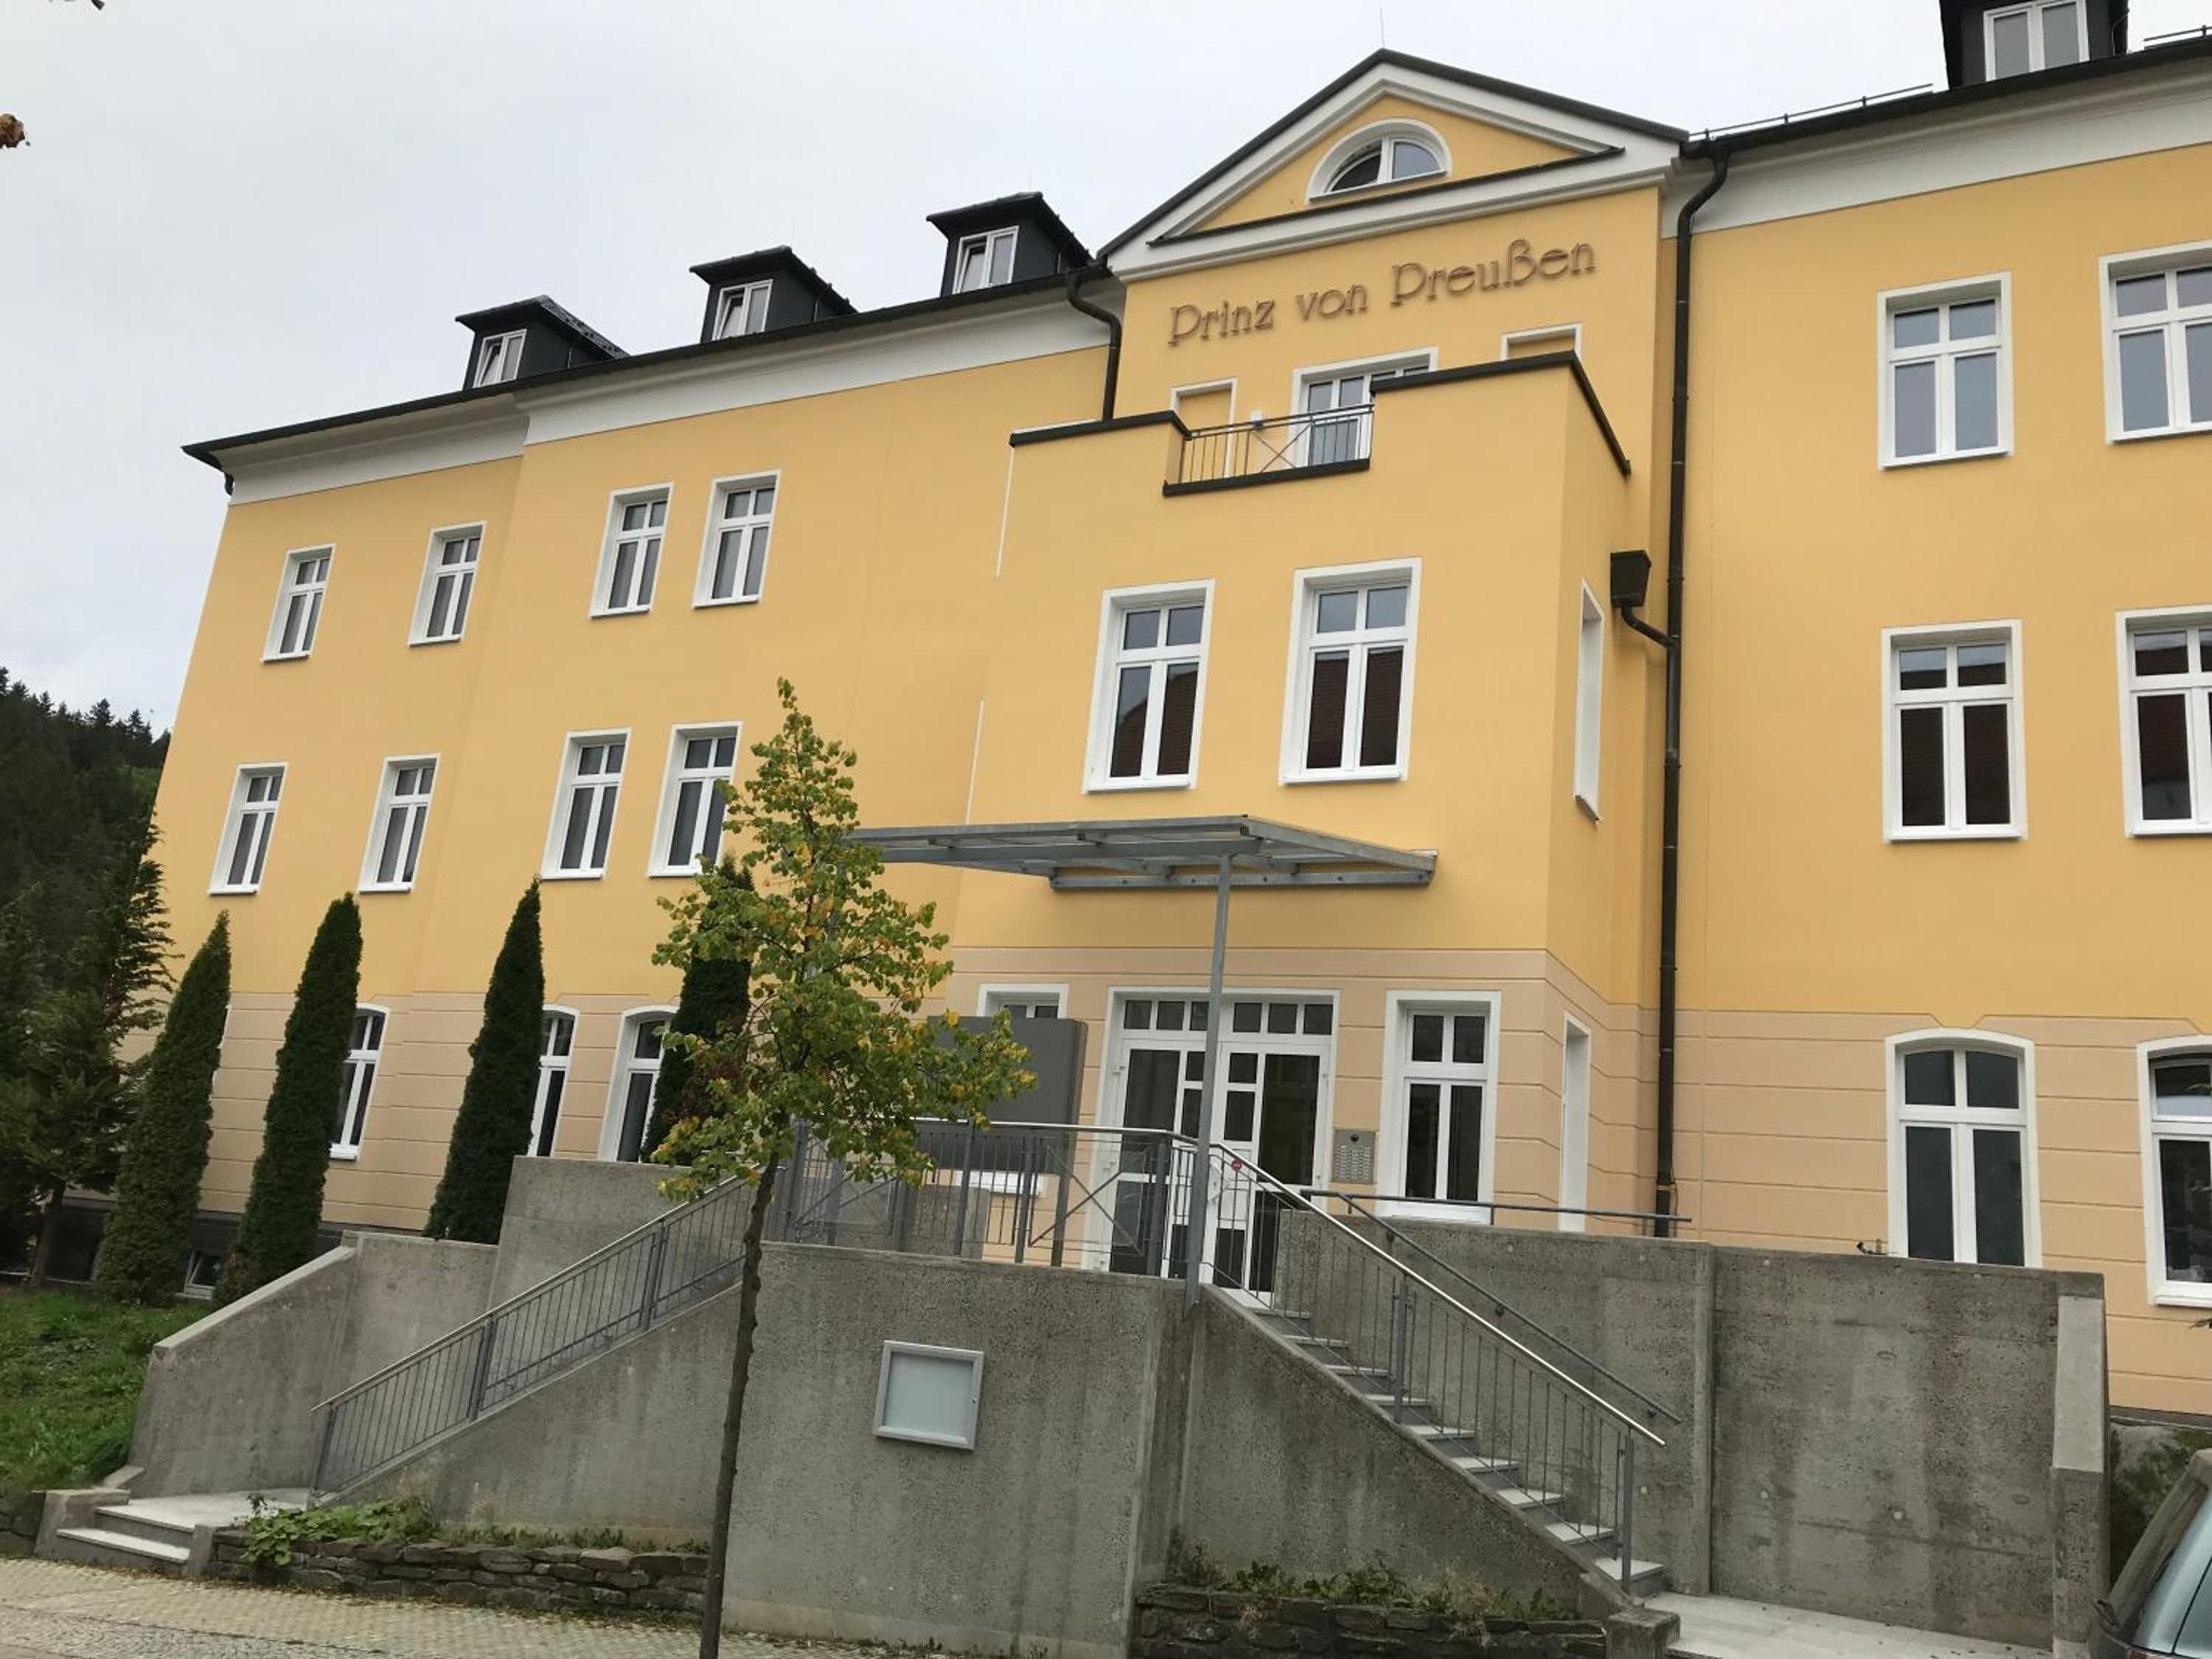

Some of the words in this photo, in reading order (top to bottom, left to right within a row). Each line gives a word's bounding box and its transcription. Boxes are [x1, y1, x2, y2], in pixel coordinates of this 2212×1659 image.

[1168, 299, 1276, 346] Prinz
[1295, 283, 1368, 321] von
[1391, 239, 1597, 307] Preußen
